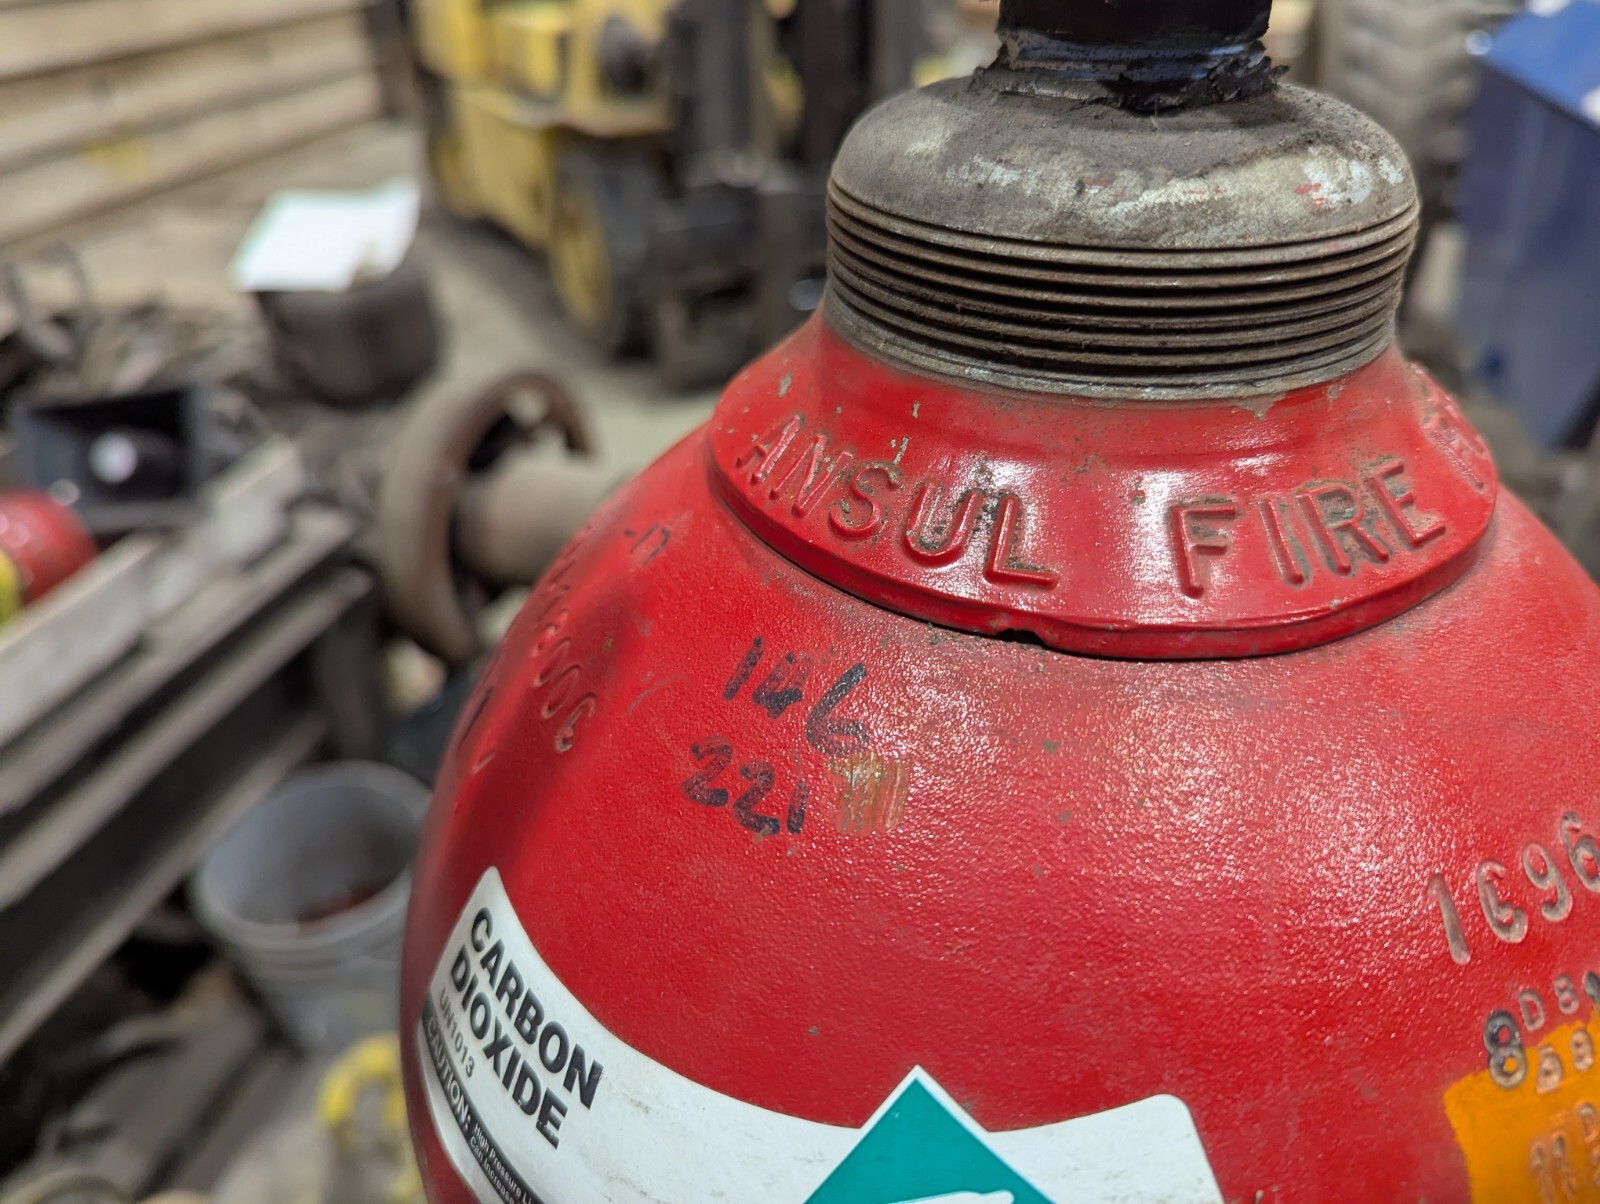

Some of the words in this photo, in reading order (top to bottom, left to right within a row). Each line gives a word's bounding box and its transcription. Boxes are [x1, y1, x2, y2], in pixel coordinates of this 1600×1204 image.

[734, 412, 1060, 590] ANSUL
[1170, 460, 1448, 598] FIRE
[682, 735, 810, 835] 221
[439, 986, 475, 1079] UN1013
[450, 943, 569, 1150] DIOXIDE
[470, 906, 604, 1110] CARBON
[470, 1135, 484, 1163] Can
[474, 1122, 490, 1153] High
[489, 1147, 522, 1197] Pressure
